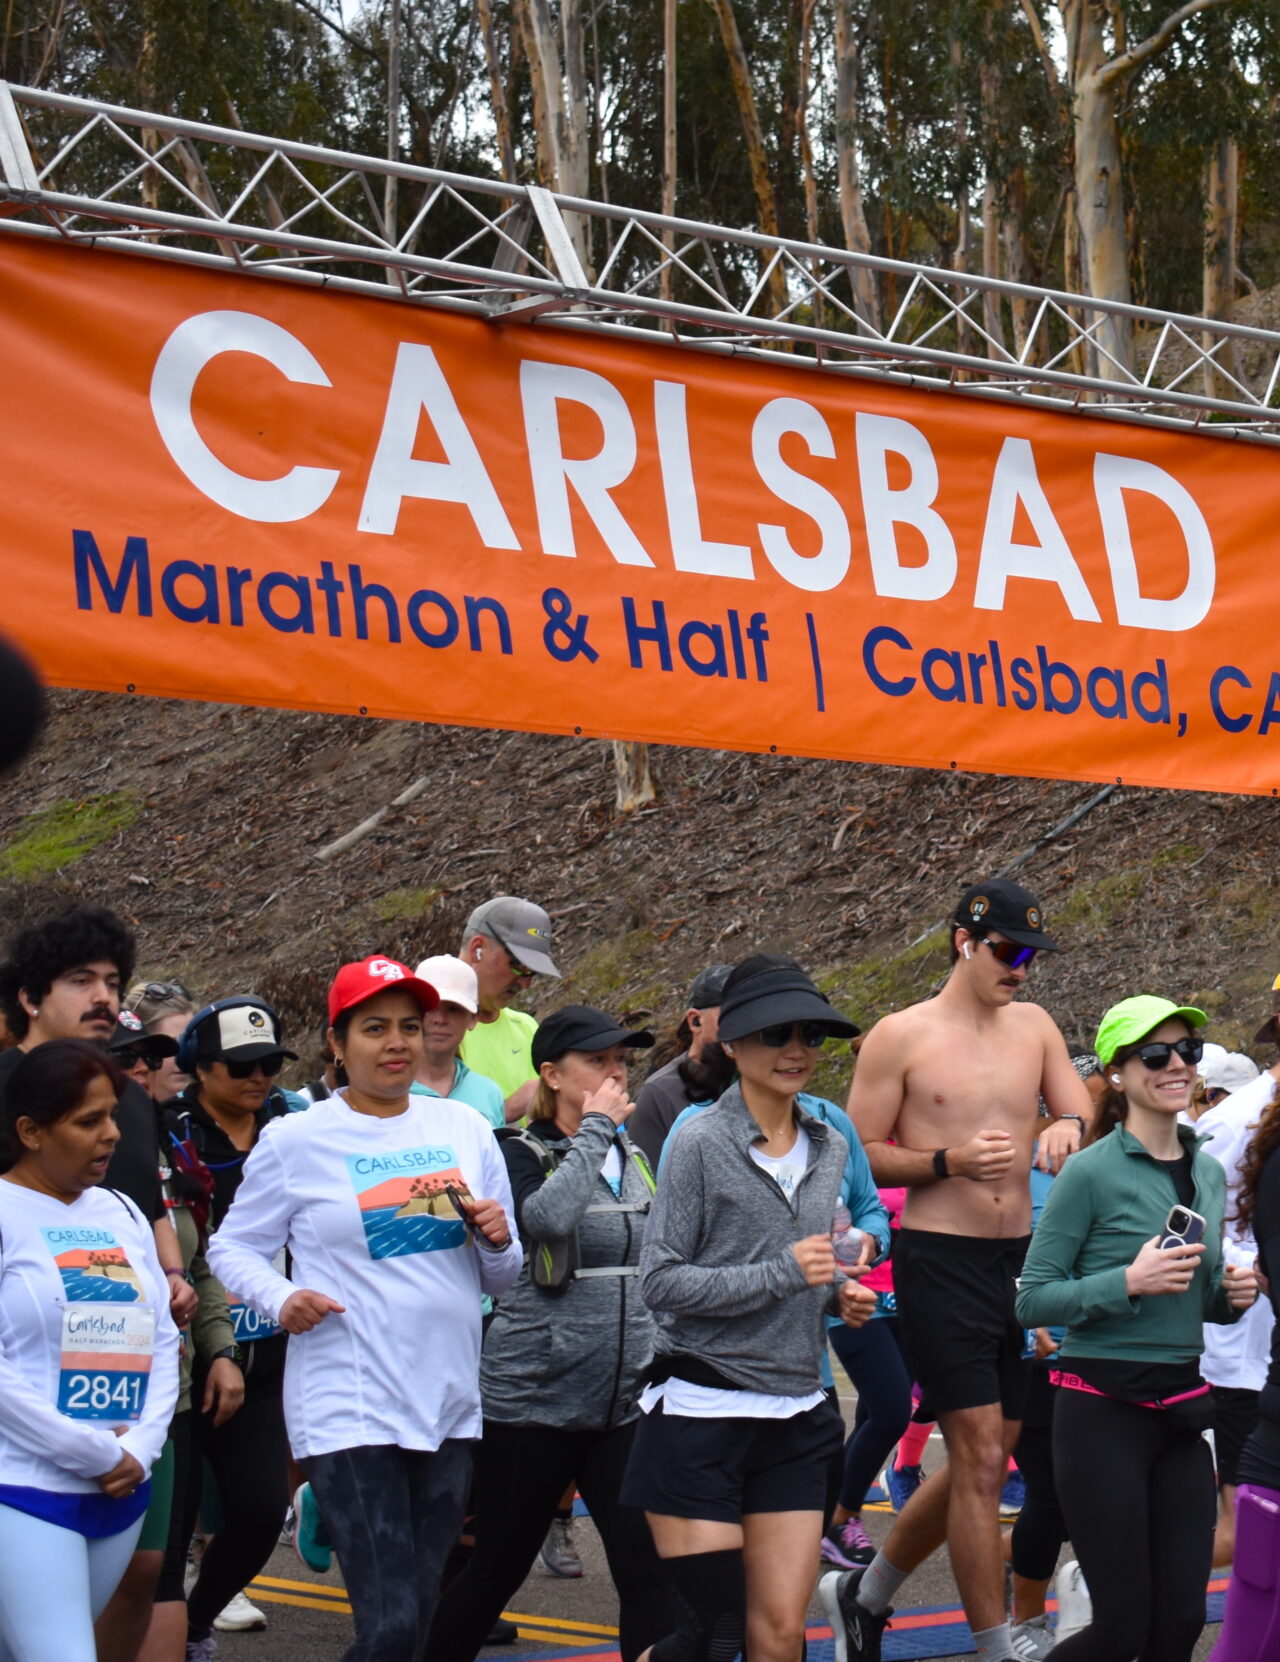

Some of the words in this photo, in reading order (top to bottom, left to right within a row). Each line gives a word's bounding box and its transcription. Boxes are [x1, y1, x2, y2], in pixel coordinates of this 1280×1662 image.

[150, 310, 1217, 631] CARLSBAD
[74, 529, 513, 655] Marathon
[542, 587, 600, 663] &
[622, 597, 771, 683] Half
[863, 626, 1187, 739] Carlsbad,
[355, 1151, 452, 1174] CARLSBAD
[67, 1374, 140, 1410] 2841
